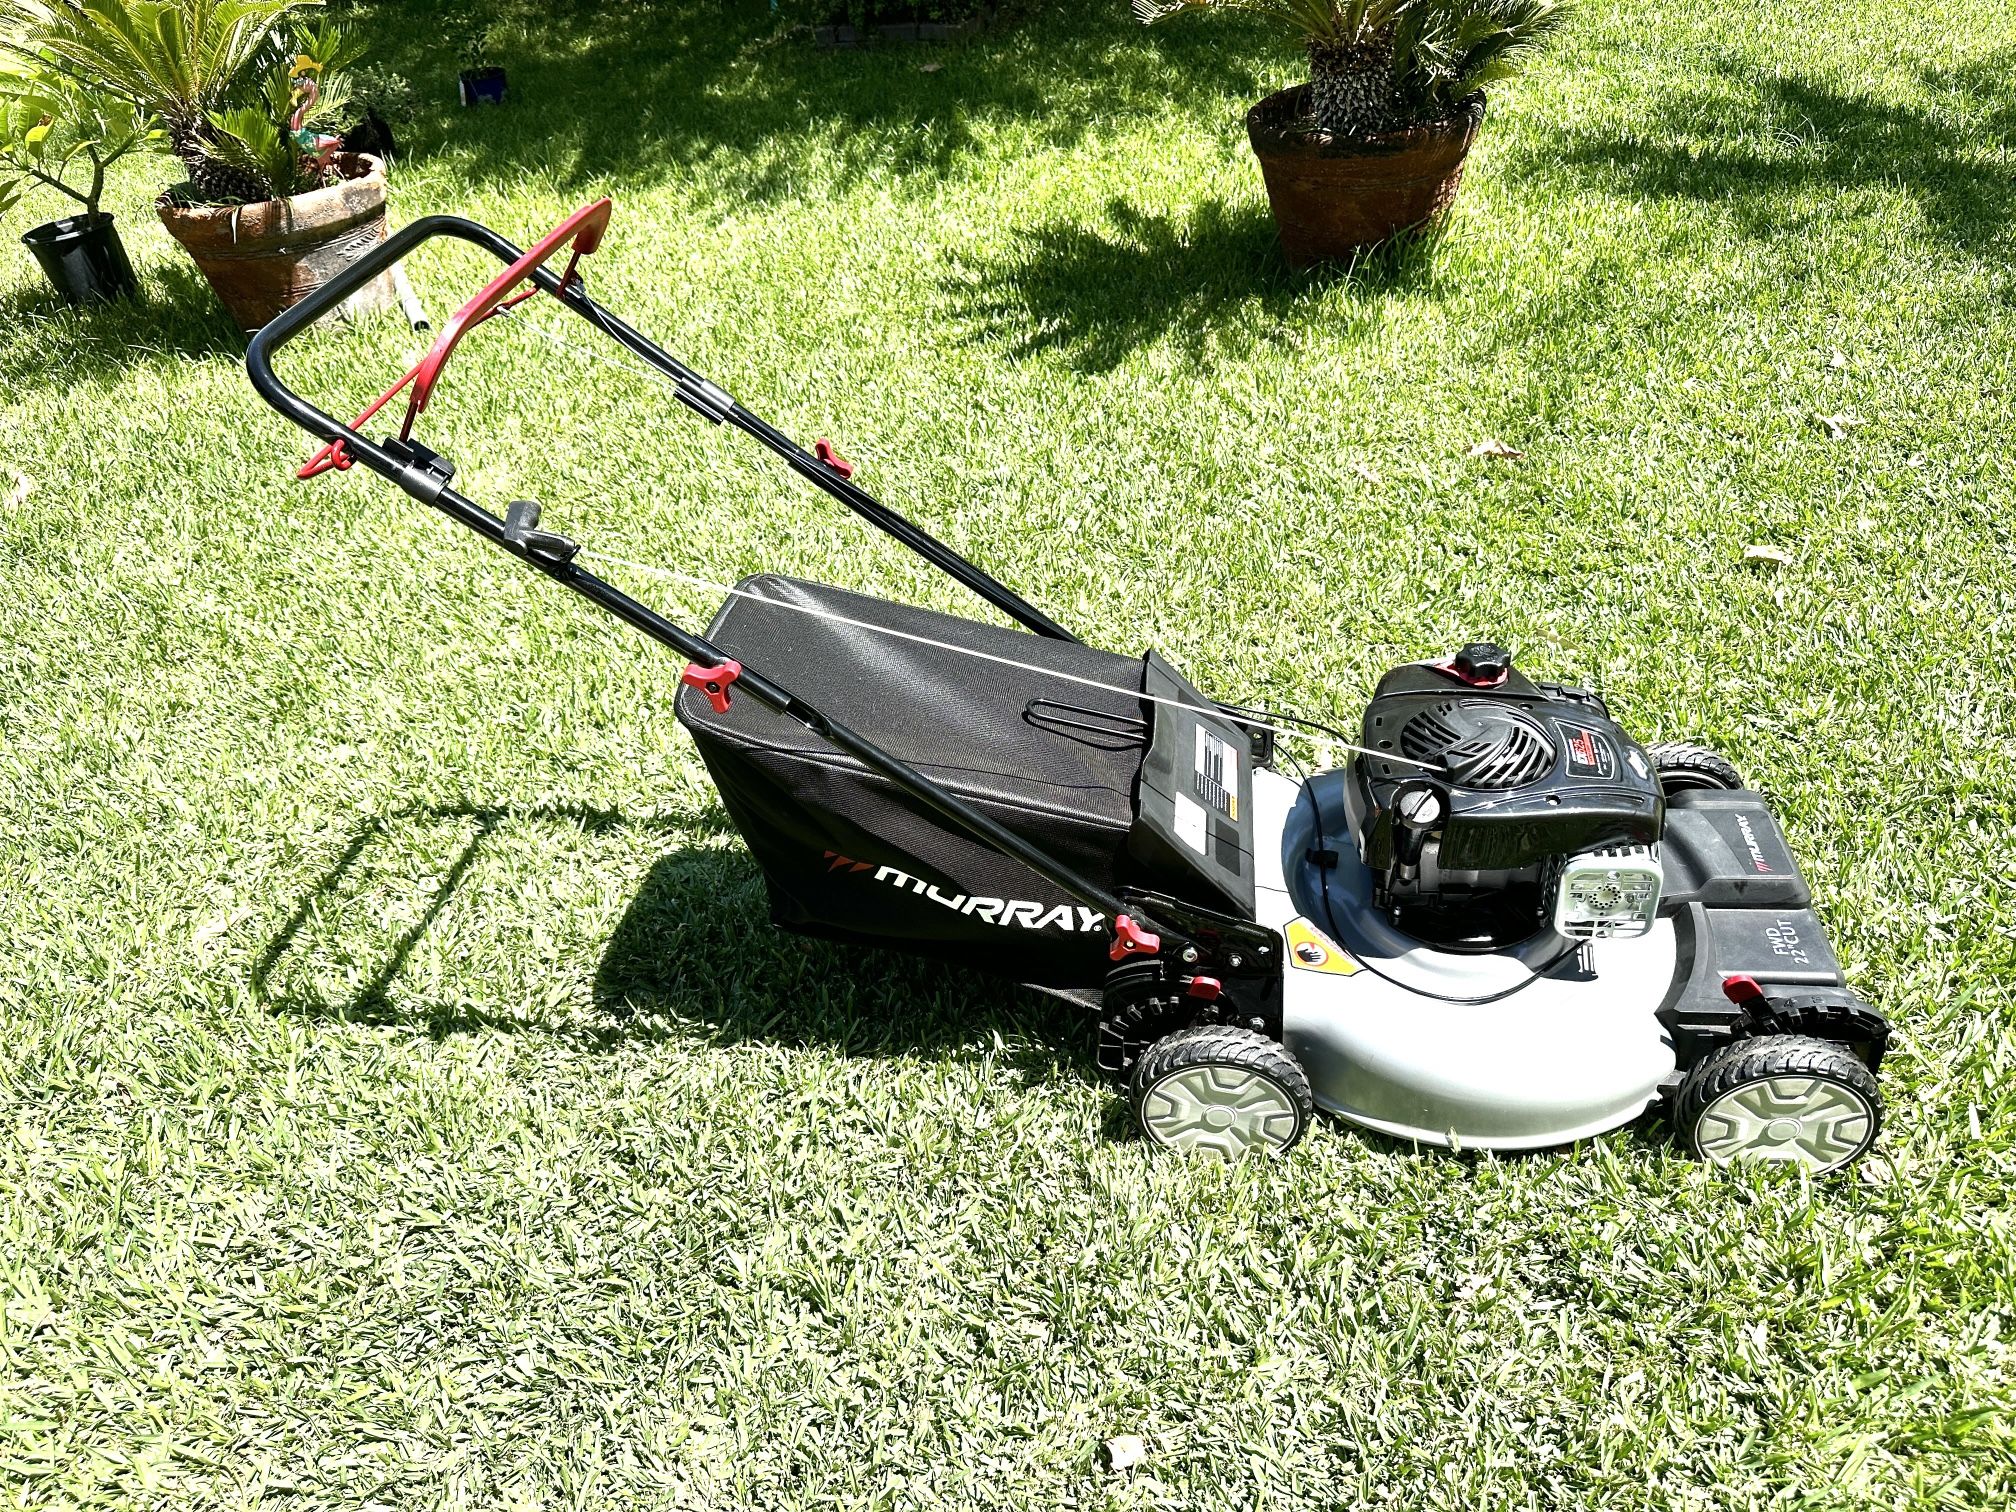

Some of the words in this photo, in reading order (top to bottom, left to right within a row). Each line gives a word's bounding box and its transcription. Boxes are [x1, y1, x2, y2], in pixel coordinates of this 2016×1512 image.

[1735, 813, 1764, 862] MURRAY
[874, 865, 1105, 932] MURRAY
[1765, 927, 1788, 955] FWD
